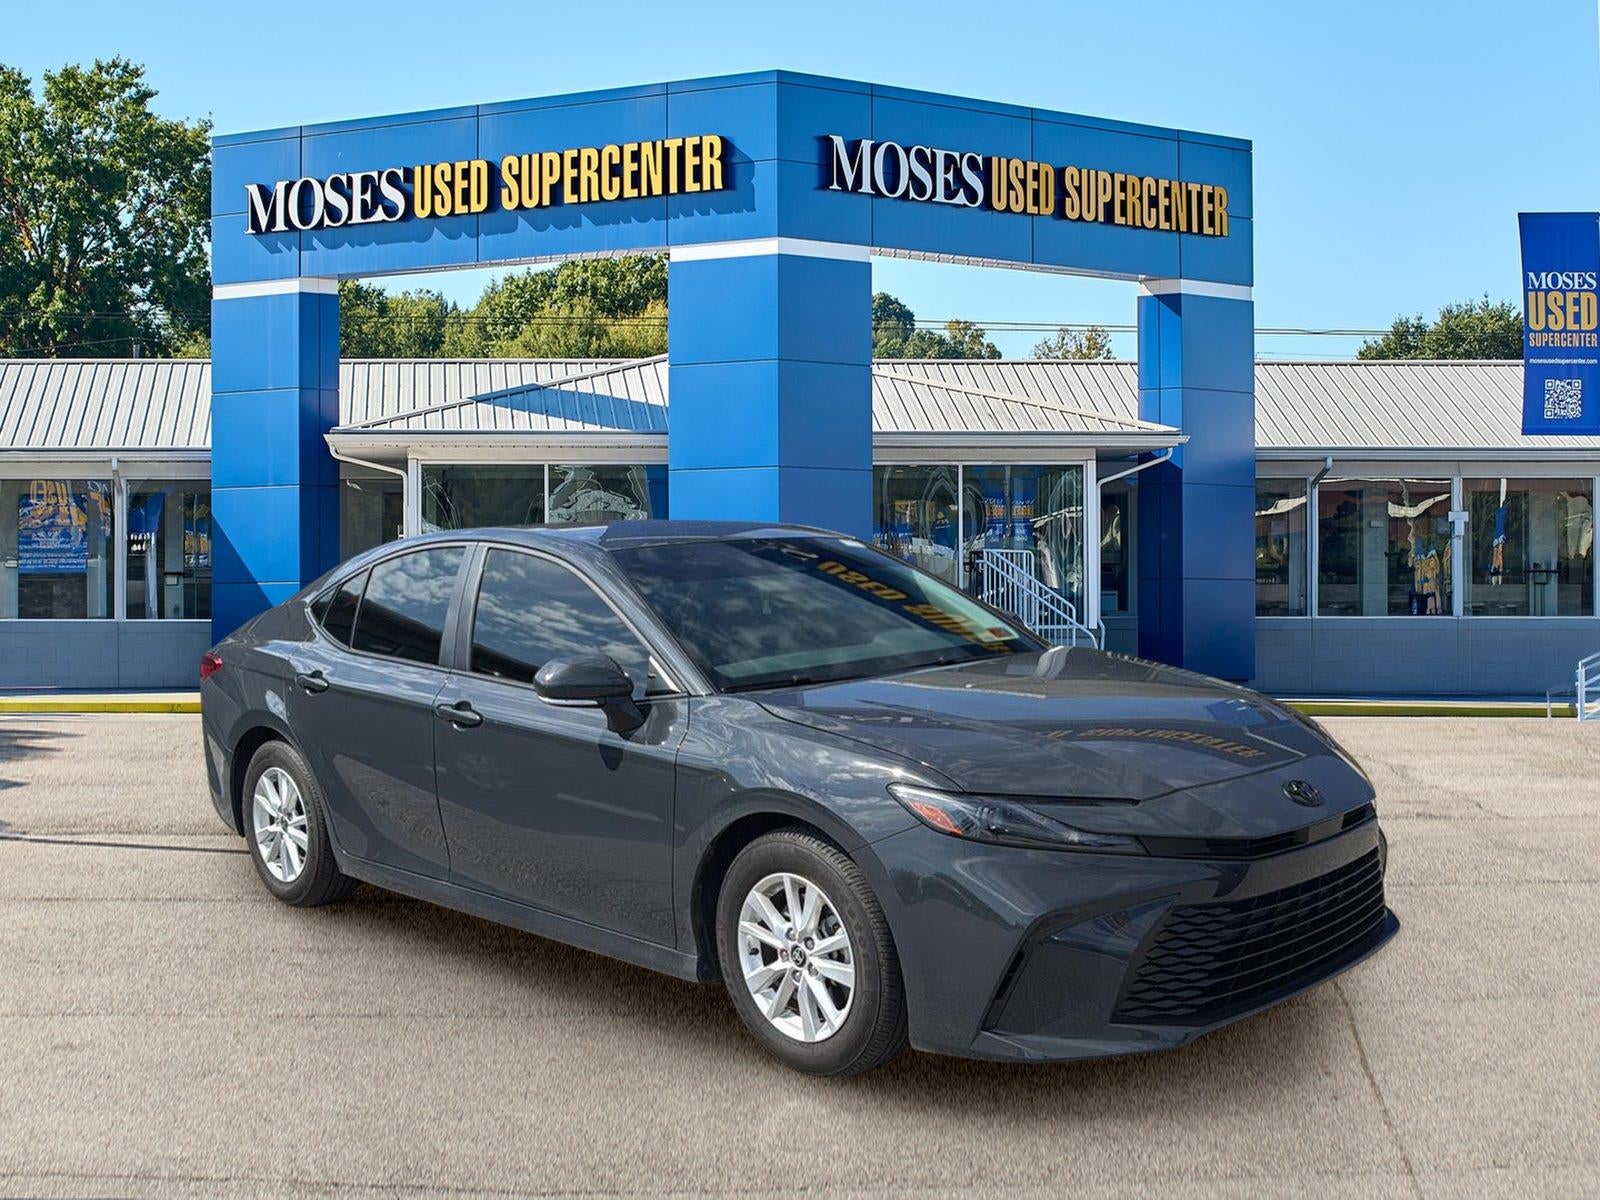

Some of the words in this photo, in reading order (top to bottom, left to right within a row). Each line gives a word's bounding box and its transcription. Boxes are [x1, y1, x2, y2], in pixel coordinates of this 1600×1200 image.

[244, 168, 405, 236] MOSES
[412, 159, 488, 220] USED
[500, 134, 723, 212] SUPERCENTER
[828, 134, 985, 208] MOSES
[991, 156, 1055, 216] USED
[1064, 165, 1230, 237] SUPERCENTER
[1527, 271, 1597, 290] MOSES
[1528, 291, 1598, 331] USED
[1529, 332, 1598, 347] SUPERCENTER
